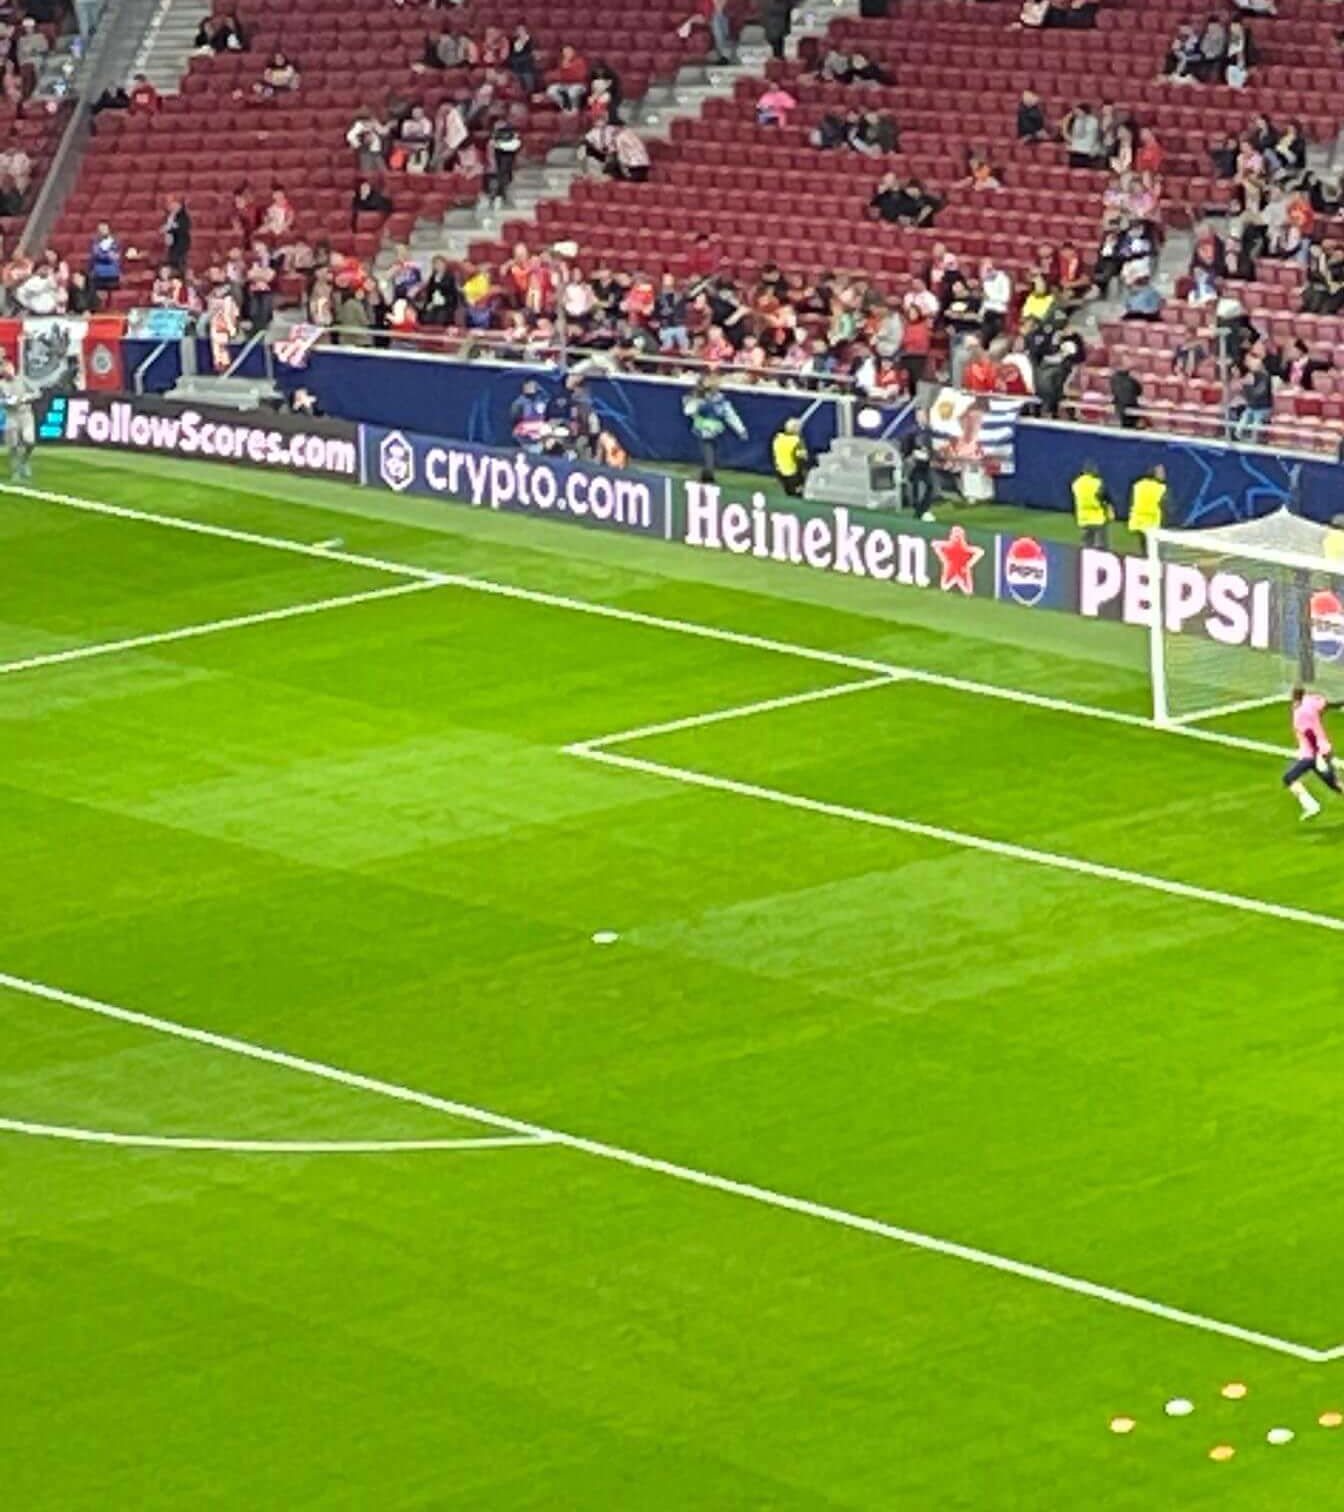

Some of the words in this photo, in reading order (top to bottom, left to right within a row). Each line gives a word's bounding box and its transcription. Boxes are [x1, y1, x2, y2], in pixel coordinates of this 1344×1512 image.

[65, 399, 356, 475] FollowScores.com
[425, 447, 651, 528] crypto.com
[685, 480, 930, 587] Heineken
[1080, 547, 1271, 649] PEPSI
